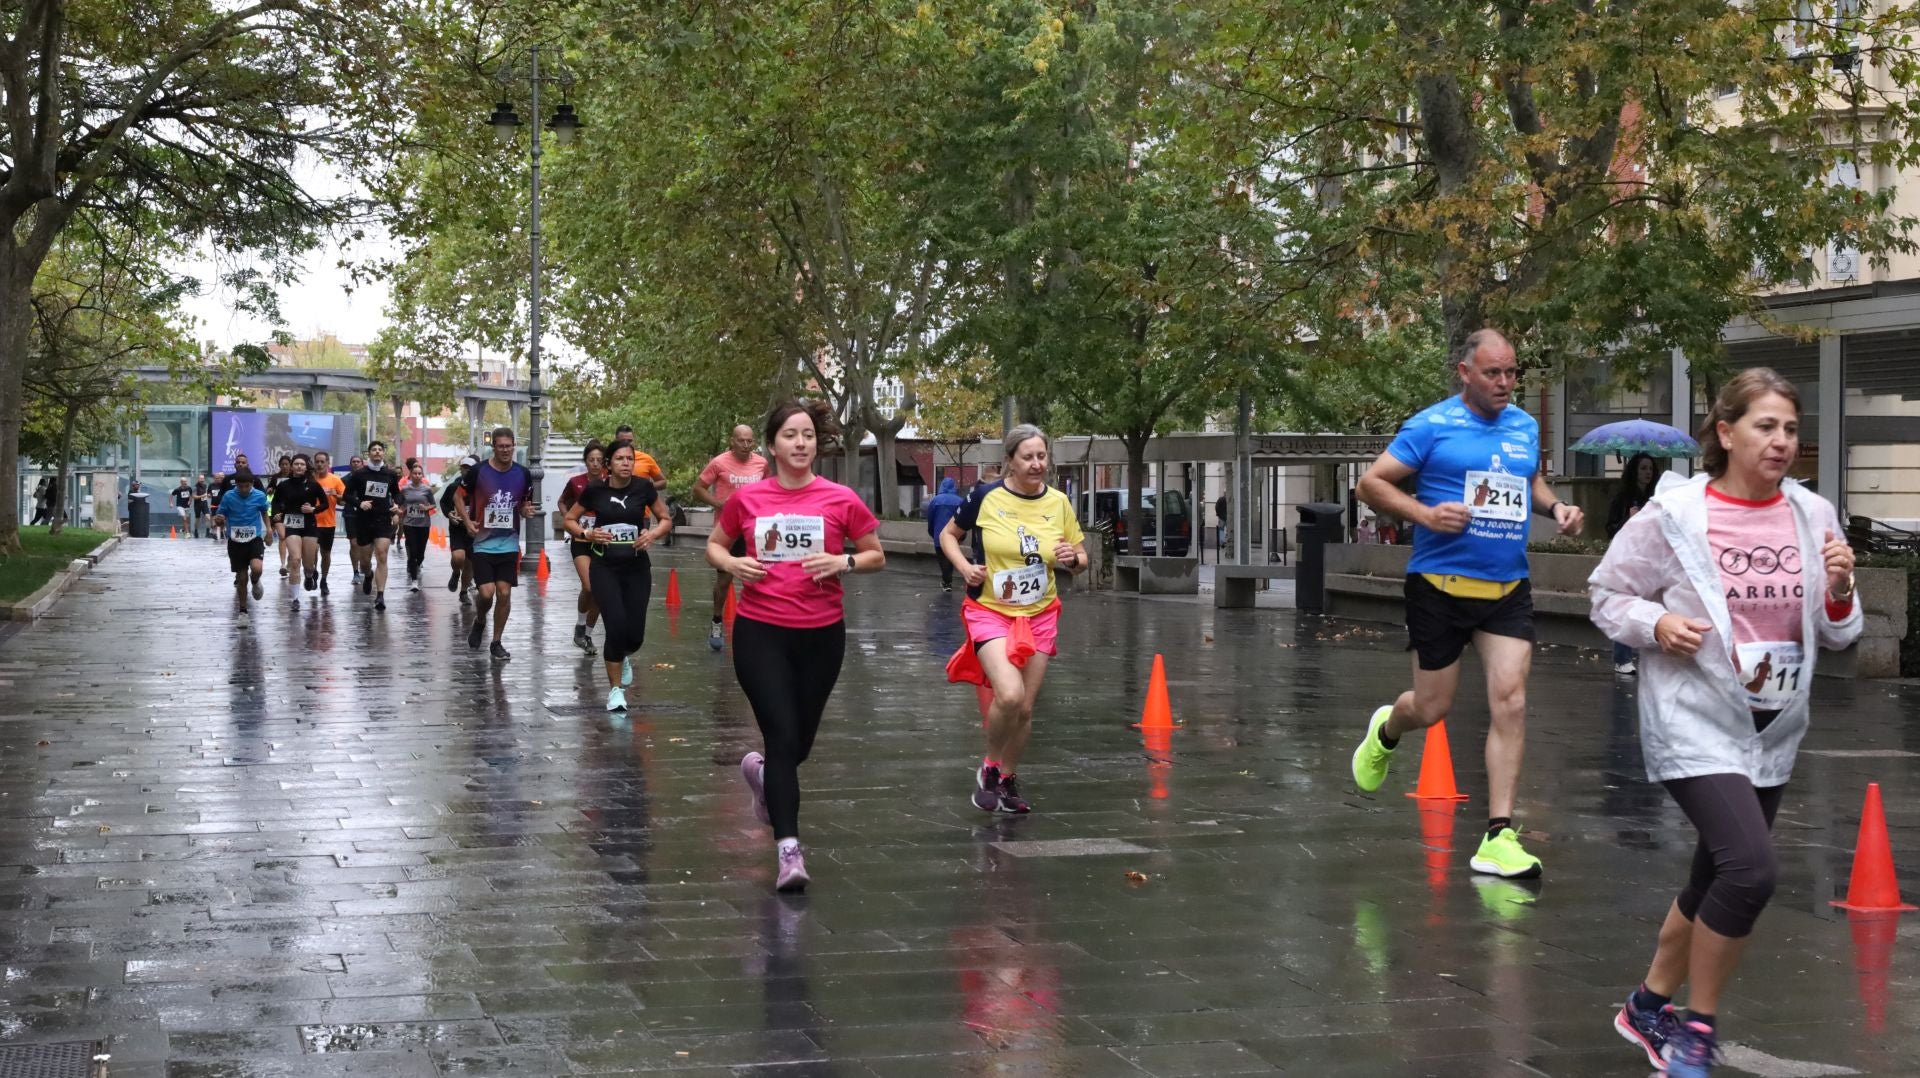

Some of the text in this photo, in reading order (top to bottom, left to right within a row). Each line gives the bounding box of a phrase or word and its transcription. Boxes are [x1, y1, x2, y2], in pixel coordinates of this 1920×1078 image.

[1280, 440, 1330, 450] CHAVAL
[1335, 440, 1353, 450] DE
[1488, 490, 1523, 508] 214
[497, 514, 510, 523] 26
[613, 532, 635, 542] 151
[785, 533, 812, 548] 95
[1020, 578, 1040, 595] 24
[1776, 667, 1800, 691] 11
